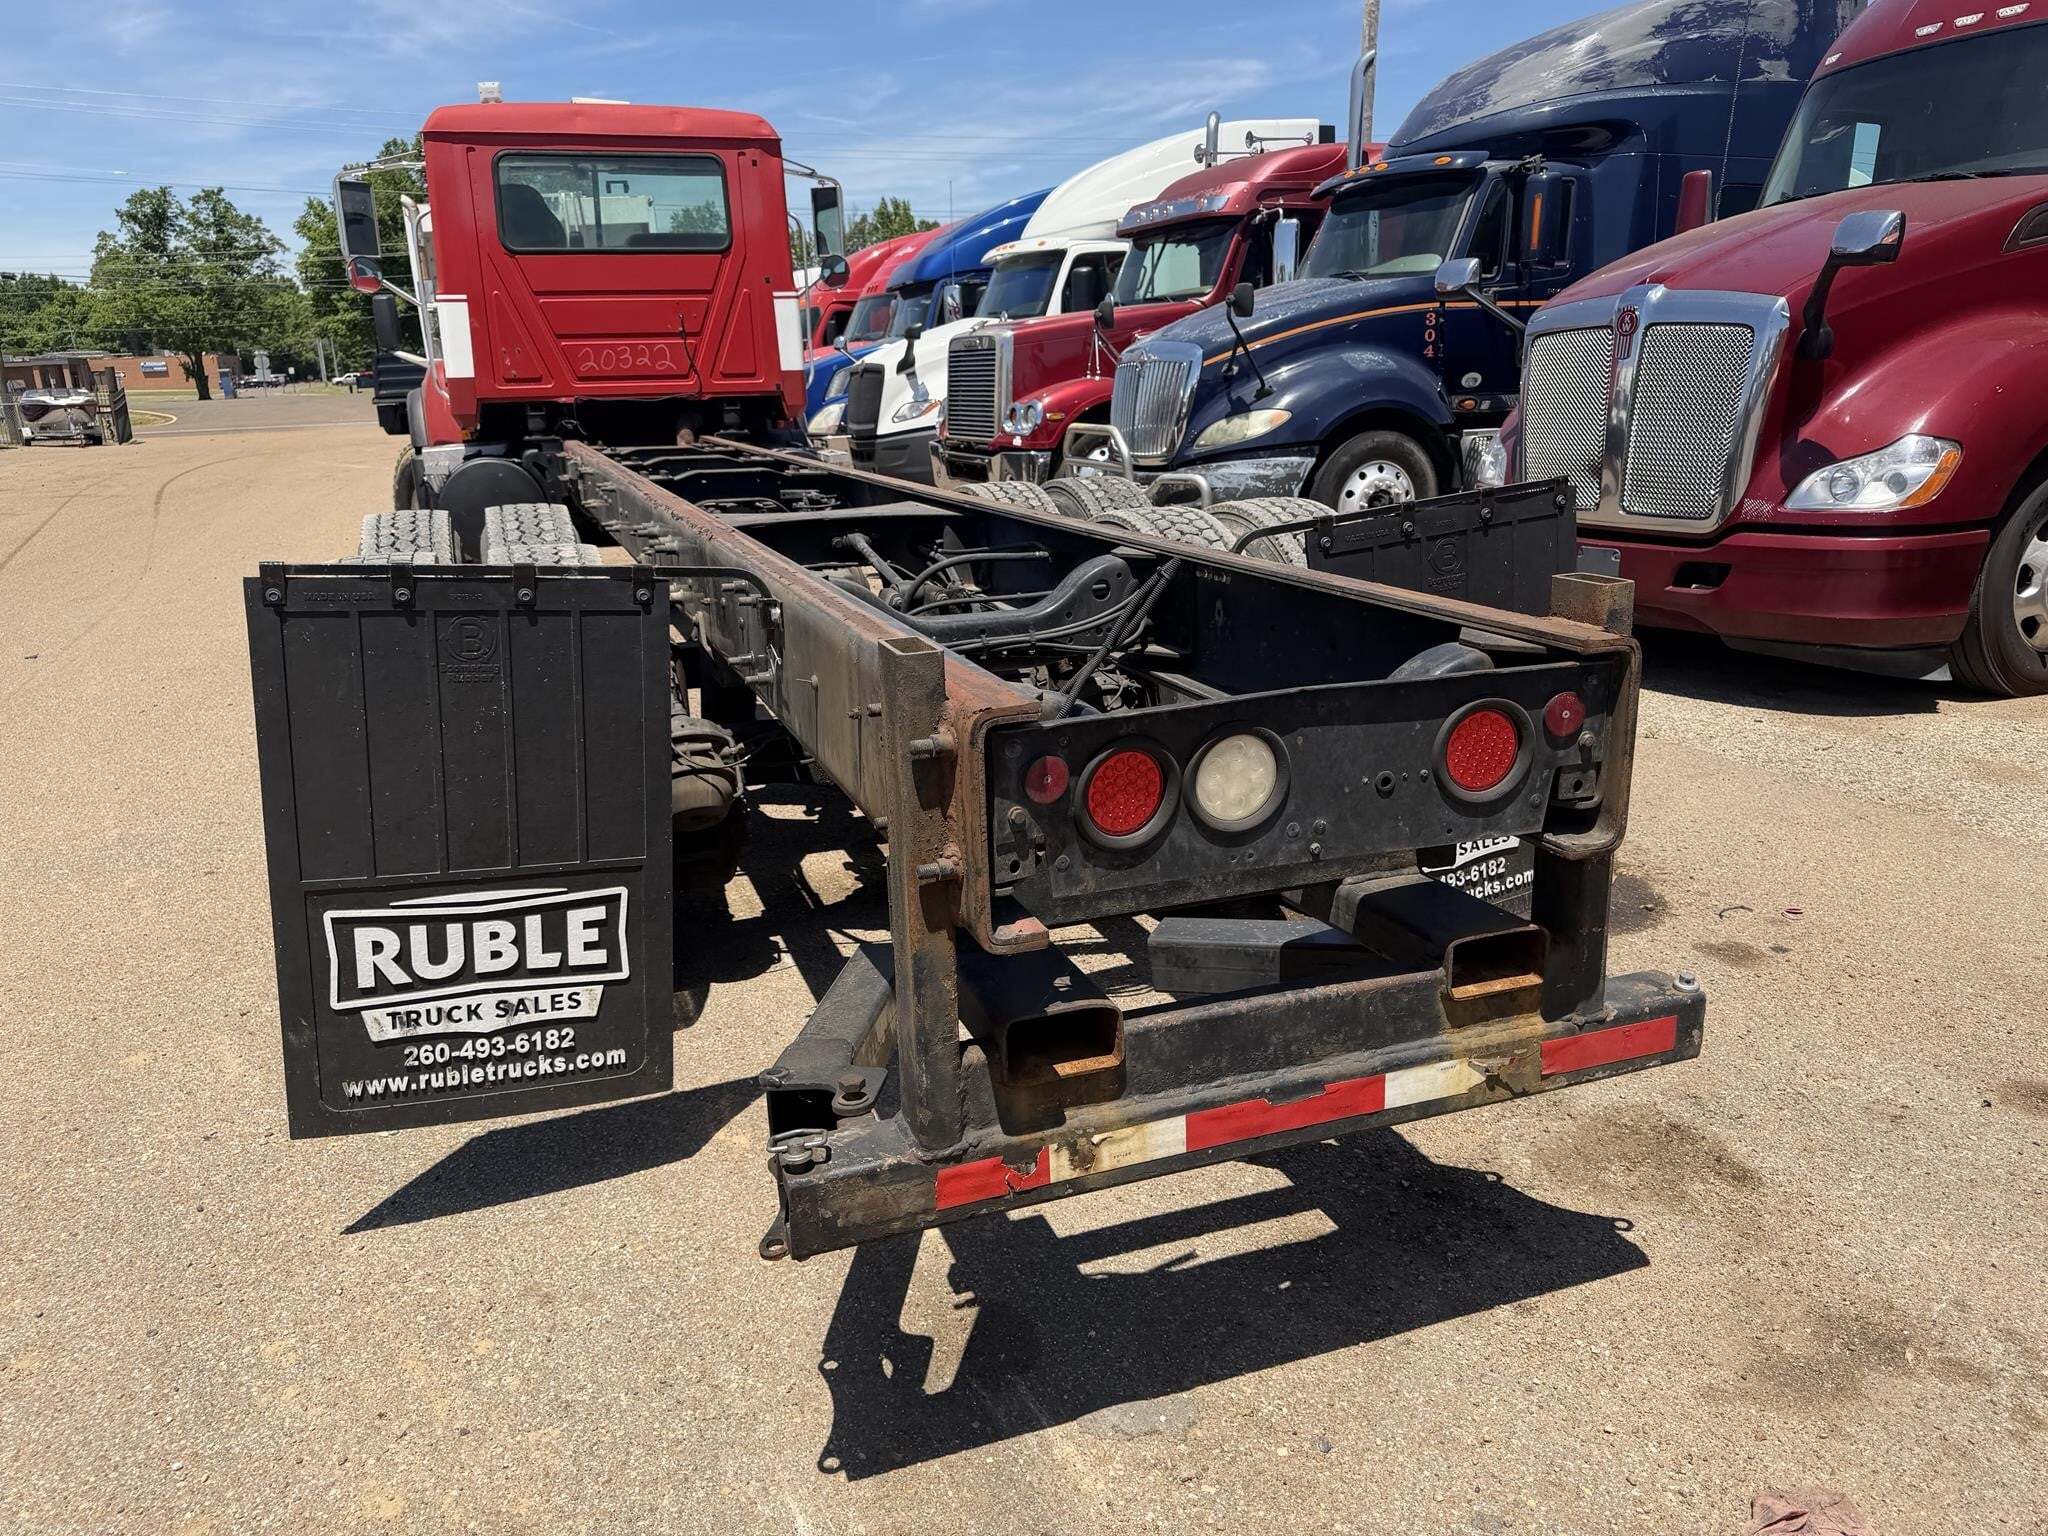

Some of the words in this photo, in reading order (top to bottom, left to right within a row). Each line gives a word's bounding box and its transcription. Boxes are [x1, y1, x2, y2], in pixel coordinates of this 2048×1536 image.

[1424, 312, 1436, 358] 304
[577, 344, 677, 371] 20322
[353, 906, 608, 989] RUBLE
[386, 1002, 483, 1031] TRUCK
[495, 991, 582, 1020] SALES
[403, 1027, 575, 1067] 260-493-6182
[342, 1047, 627, 1099] www.rubletrucks.com
